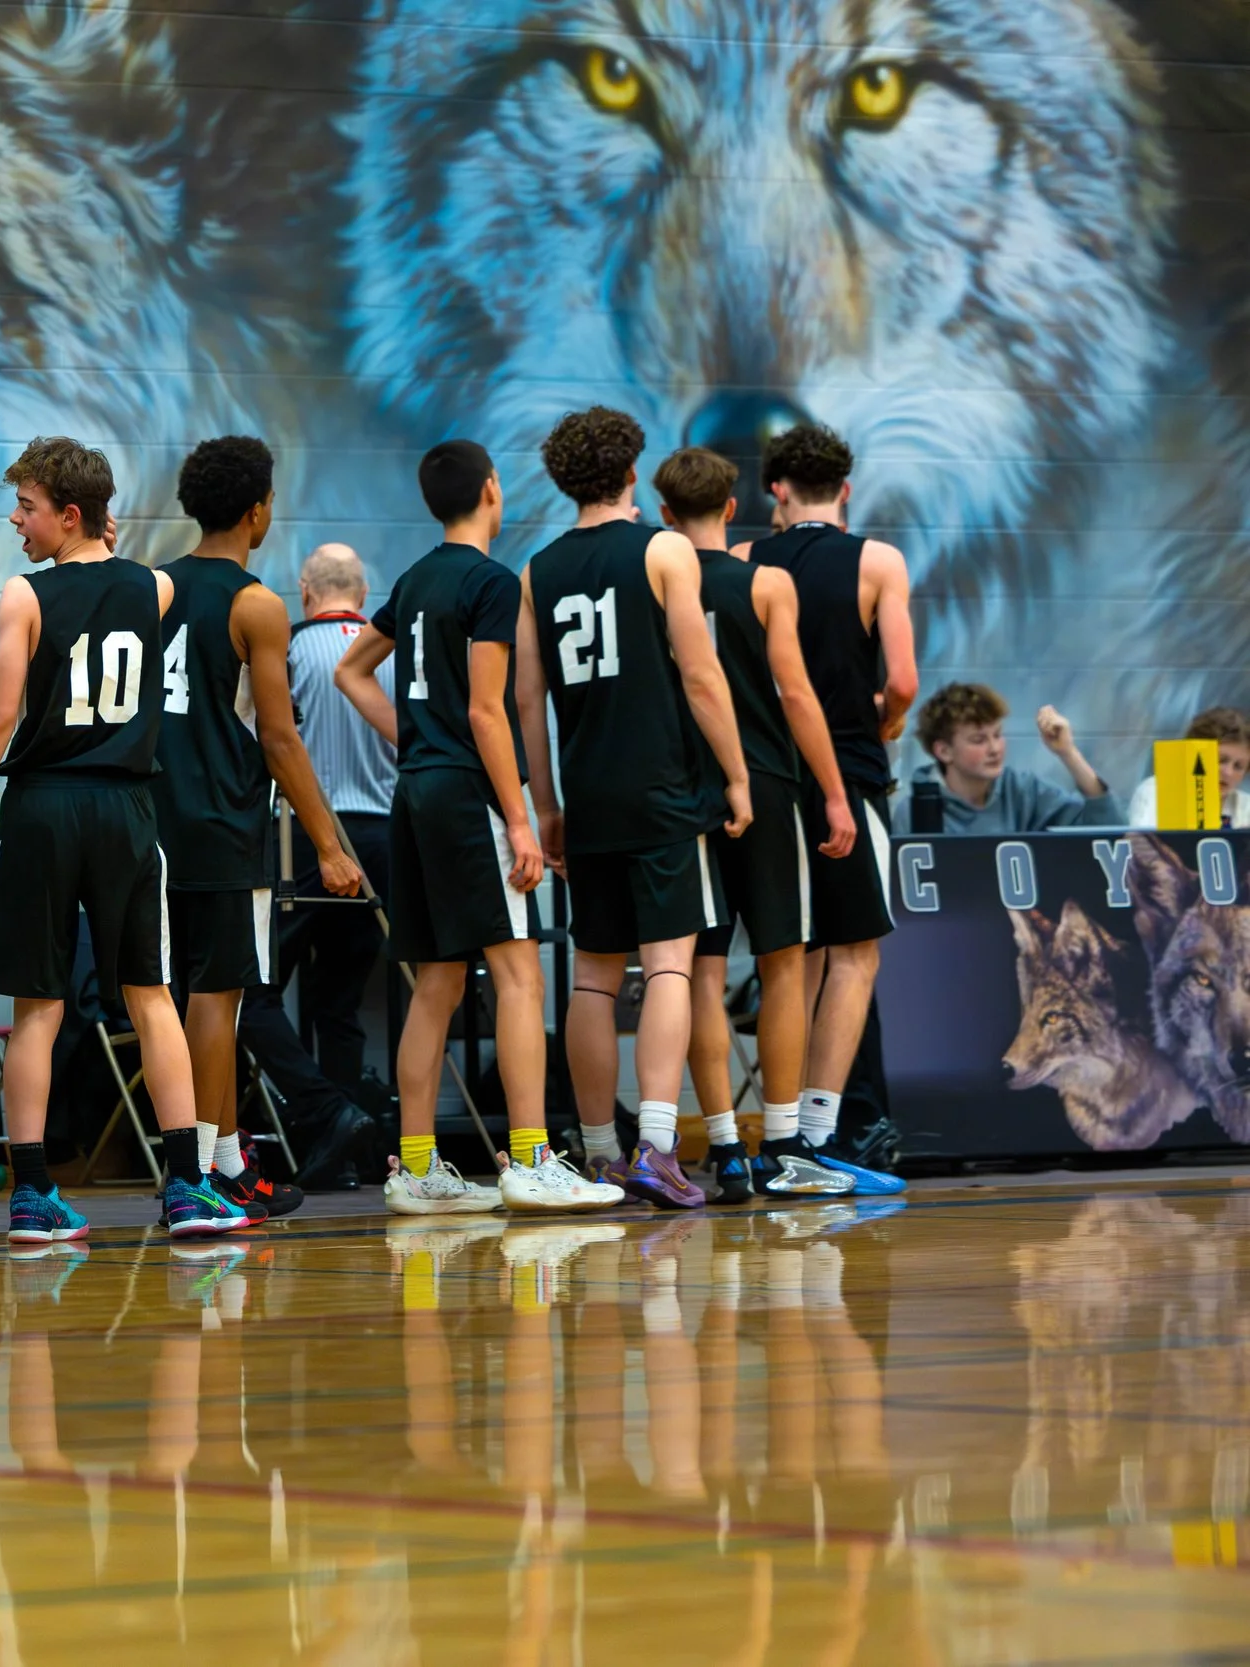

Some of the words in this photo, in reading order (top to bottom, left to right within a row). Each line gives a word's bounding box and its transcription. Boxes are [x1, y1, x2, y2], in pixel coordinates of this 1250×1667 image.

[65, 630, 144, 727] 10
[163, 623, 190, 715] 4
[408, 611, 429, 700] 1
[553, 587, 620, 685] 21
